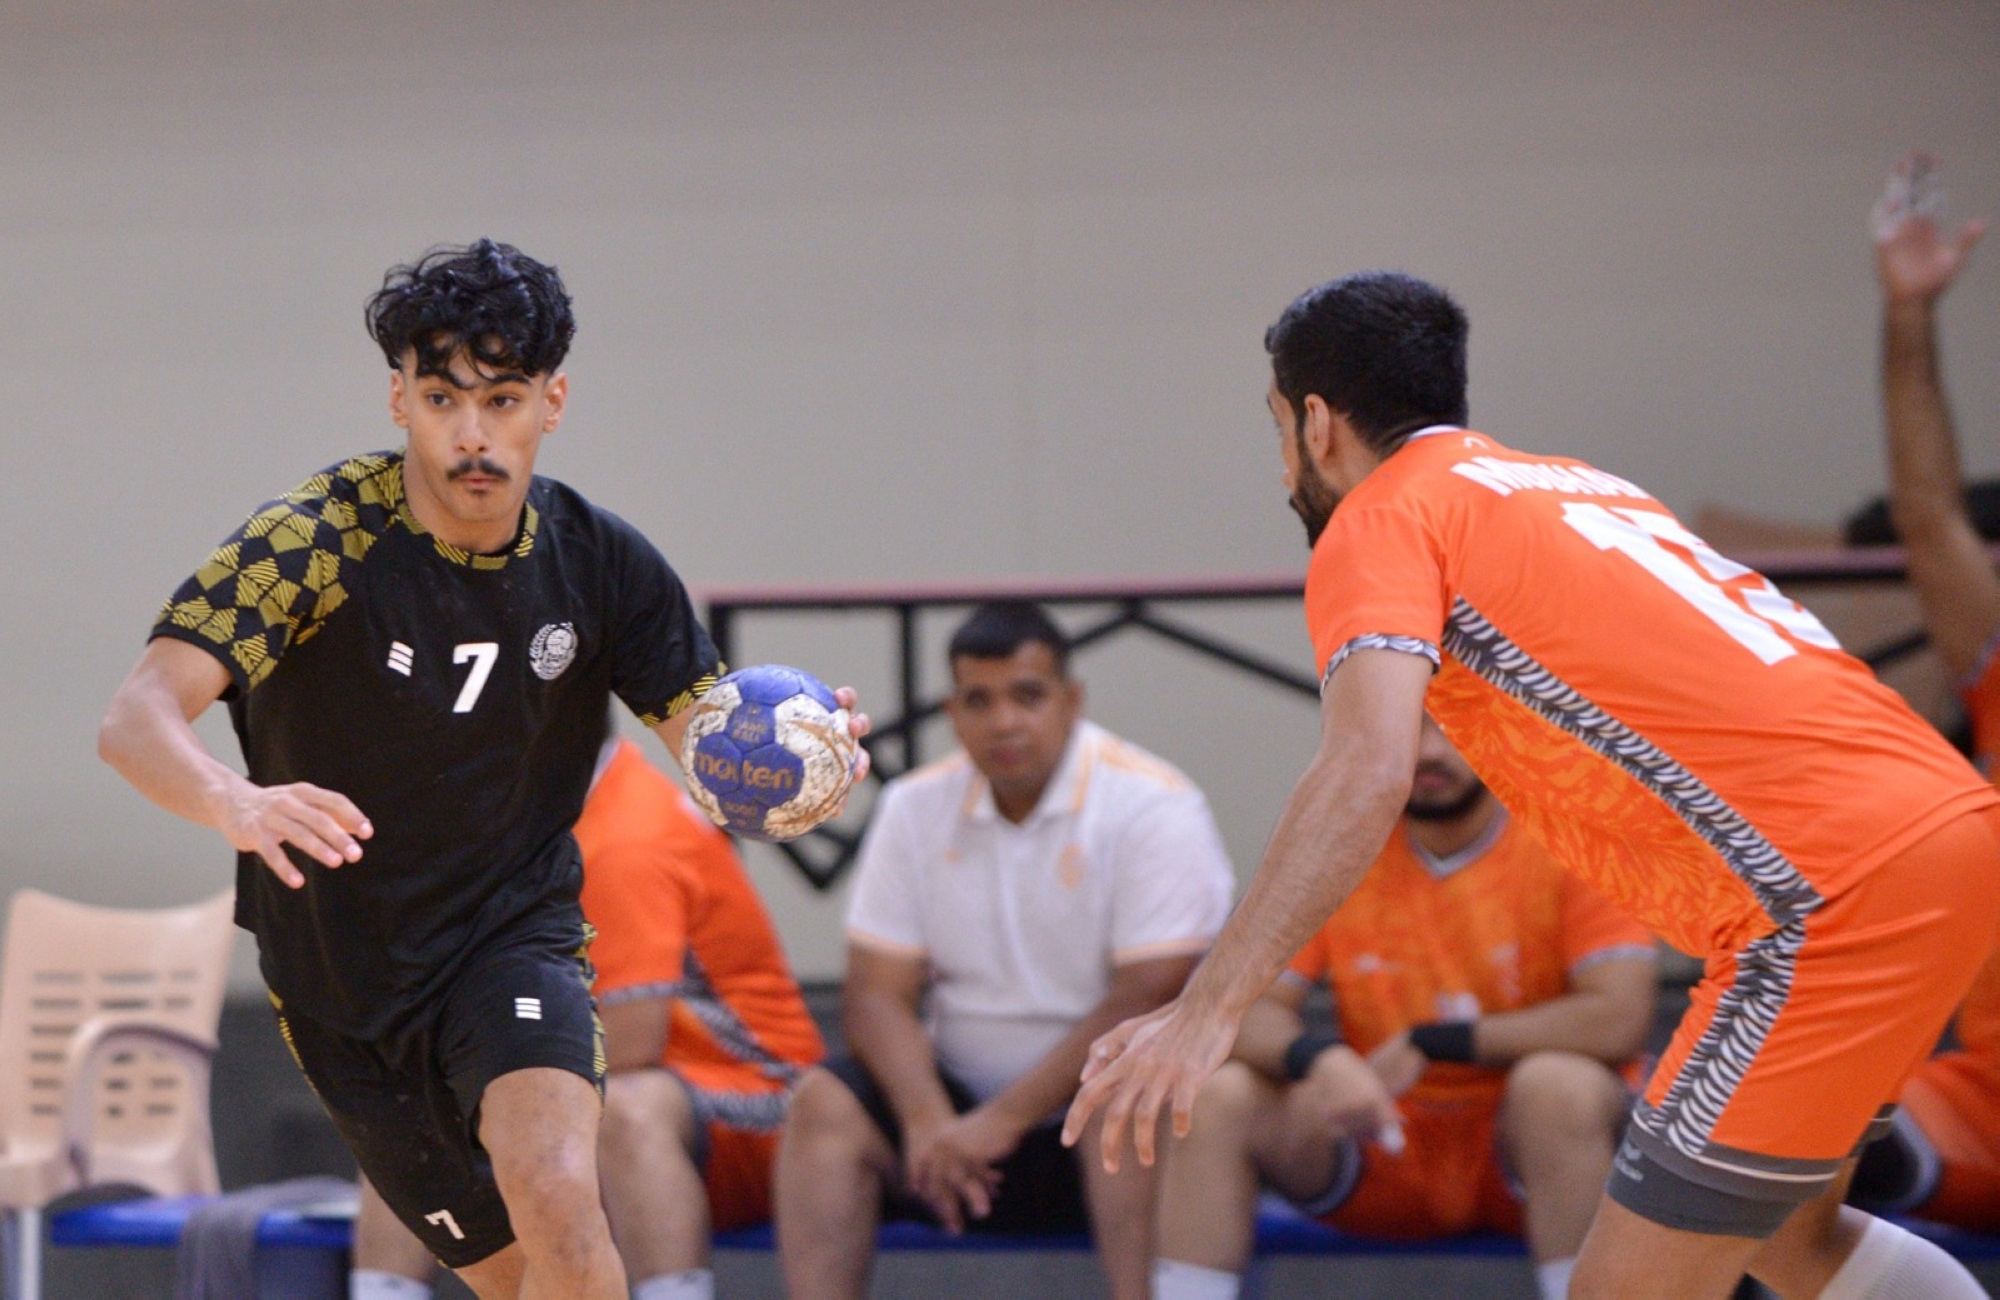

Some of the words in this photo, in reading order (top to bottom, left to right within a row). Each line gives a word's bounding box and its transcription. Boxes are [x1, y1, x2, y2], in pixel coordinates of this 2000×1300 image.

[453, 642, 500, 713] 7
[696, 751, 794, 789] molten
[424, 1209, 465, 1240] 7
